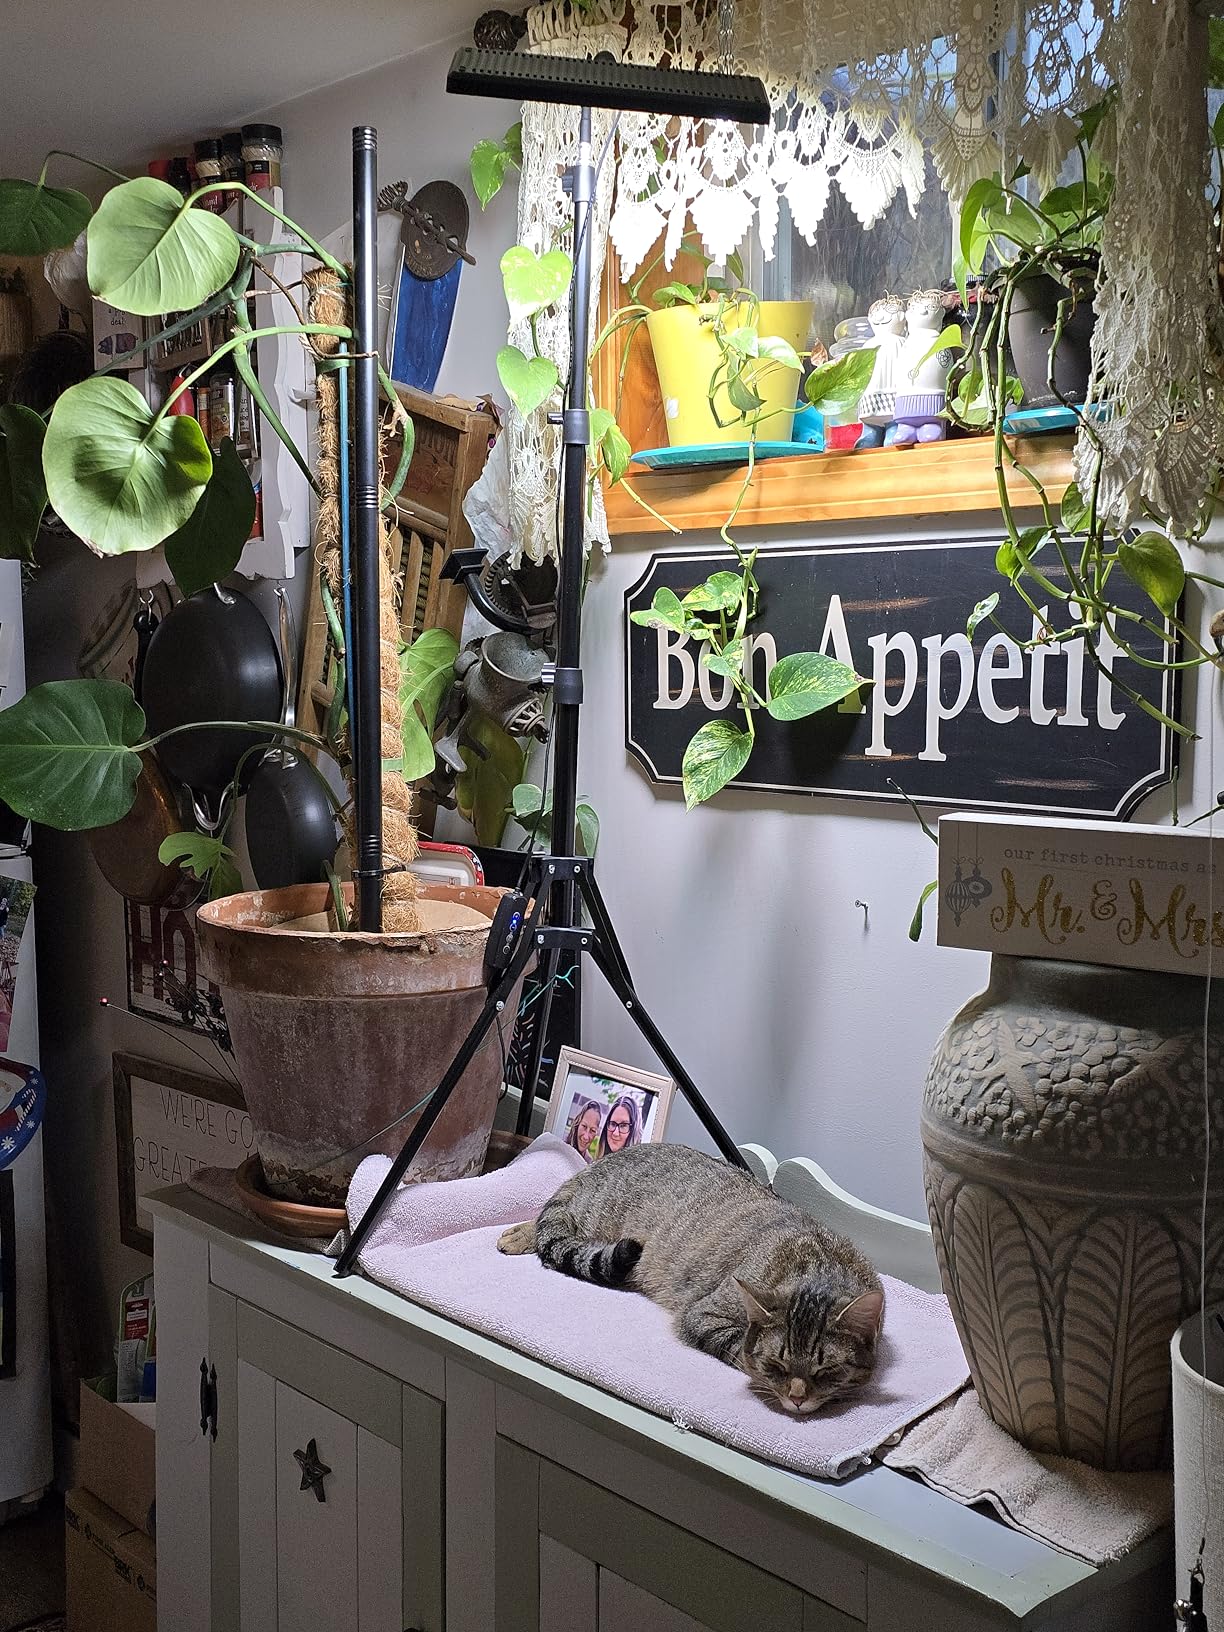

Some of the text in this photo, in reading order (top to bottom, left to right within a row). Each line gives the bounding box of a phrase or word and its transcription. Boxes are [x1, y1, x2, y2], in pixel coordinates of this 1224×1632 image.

[653, 590, 1129, 762] Bon Appetit
[1004, 848, 1217, 874] our first christmas as
[990, 867, 1086, 945] Mr.
[1090, 879, 1117, 920] &
[159, 1087, 217, 1138] WE'RE
[134, 1137, 207, 1183] GREAT
